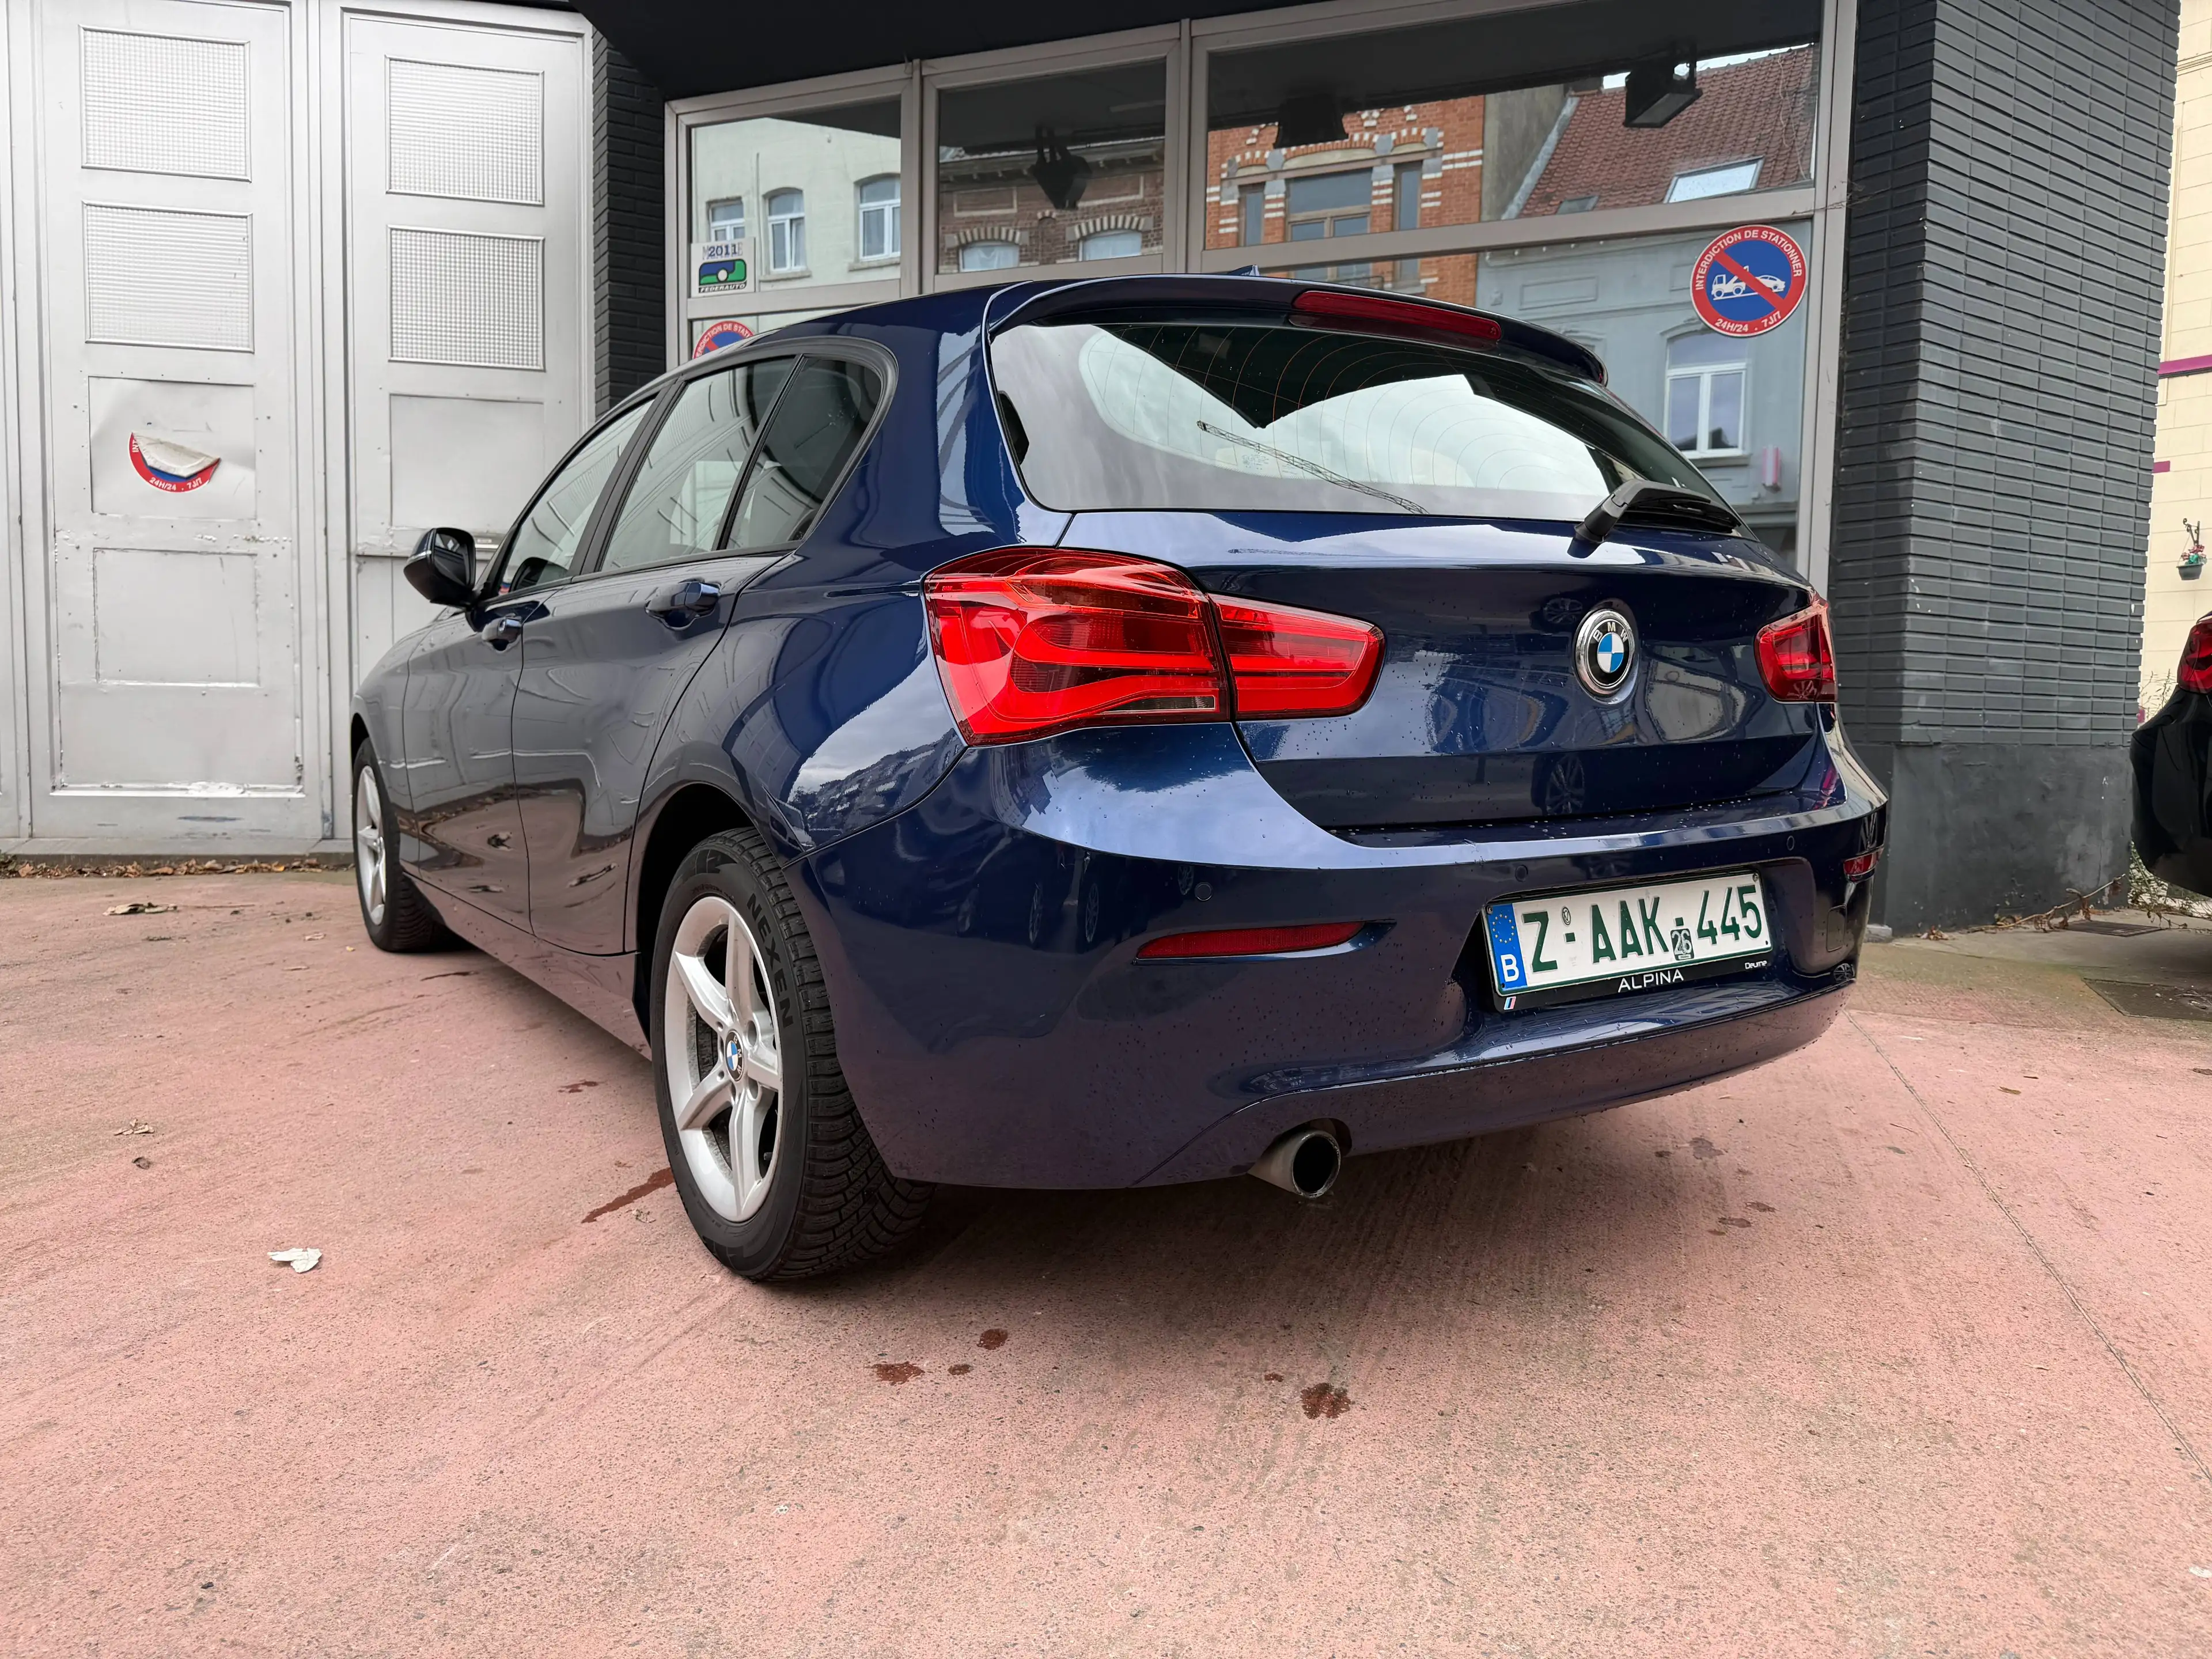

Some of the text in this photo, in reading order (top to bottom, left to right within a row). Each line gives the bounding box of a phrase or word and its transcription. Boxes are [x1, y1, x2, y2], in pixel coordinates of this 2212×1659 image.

[709, 244, 738, 257] 2011
[1695, 229, 1802, 290] INTERDICTION DE STATIONNER
[1715, 319, 1748, 332] 24H/24
[696, 324, 722, 358] ERDICTION
[723, 323, 733, 331] DE
[149, 477, 176, 491] 24H/24
[1593, 622, 1628, 643] BMW
[1522, 884, 1763, 974] Z-AAK-445
[1672, 930, 1692, 955] 26
[747, 893, 794, 1029] NEXEN
[1500, 953, 1520, 983] B
[1618, 969, 1684, 993] ALPINA
[733, 1035, 743, 1074] BMW
